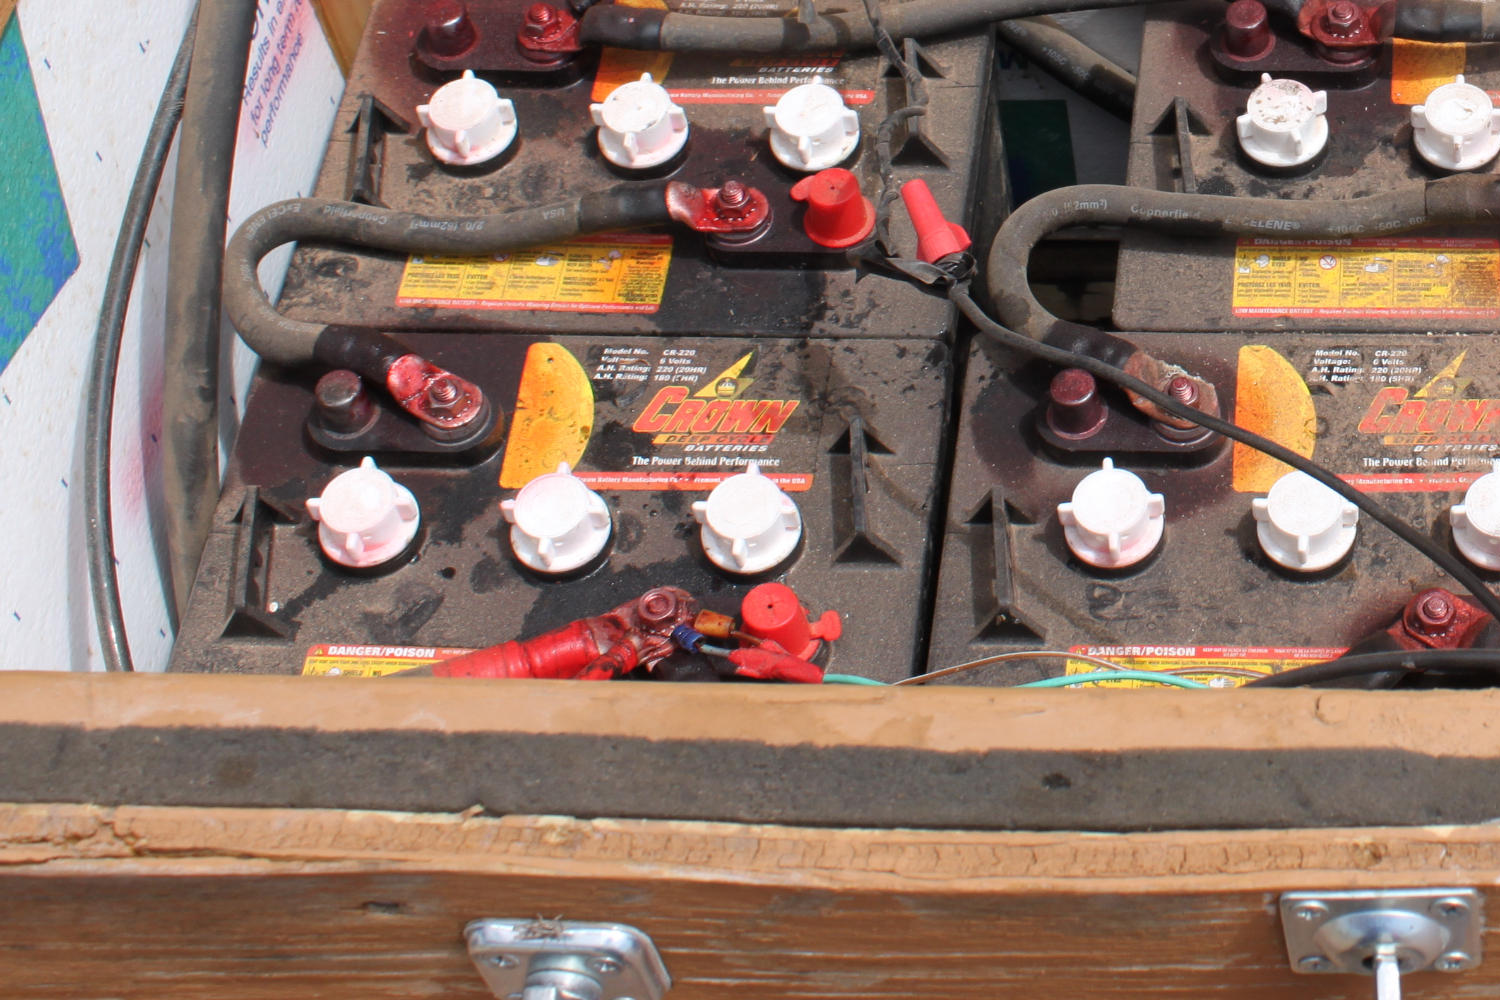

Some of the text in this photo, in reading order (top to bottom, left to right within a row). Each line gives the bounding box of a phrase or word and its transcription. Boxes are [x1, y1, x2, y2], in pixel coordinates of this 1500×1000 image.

[260, 56, 281, 94] long
[261, 32, 304, 149] performance
[632, 385, 801, 433] CROWN
[685, 444, 768, 452] BATTERIES
[632, 456, 649, 466] The
[651, 457, 681, 466] Power
[685, 457, 717, 466] Behind
[1363, 458, 1413, 467] The Power
[328, 645, 435, 658] DANGER/POISON
[1087, 646, 1195, 657] DANGER/POISON
